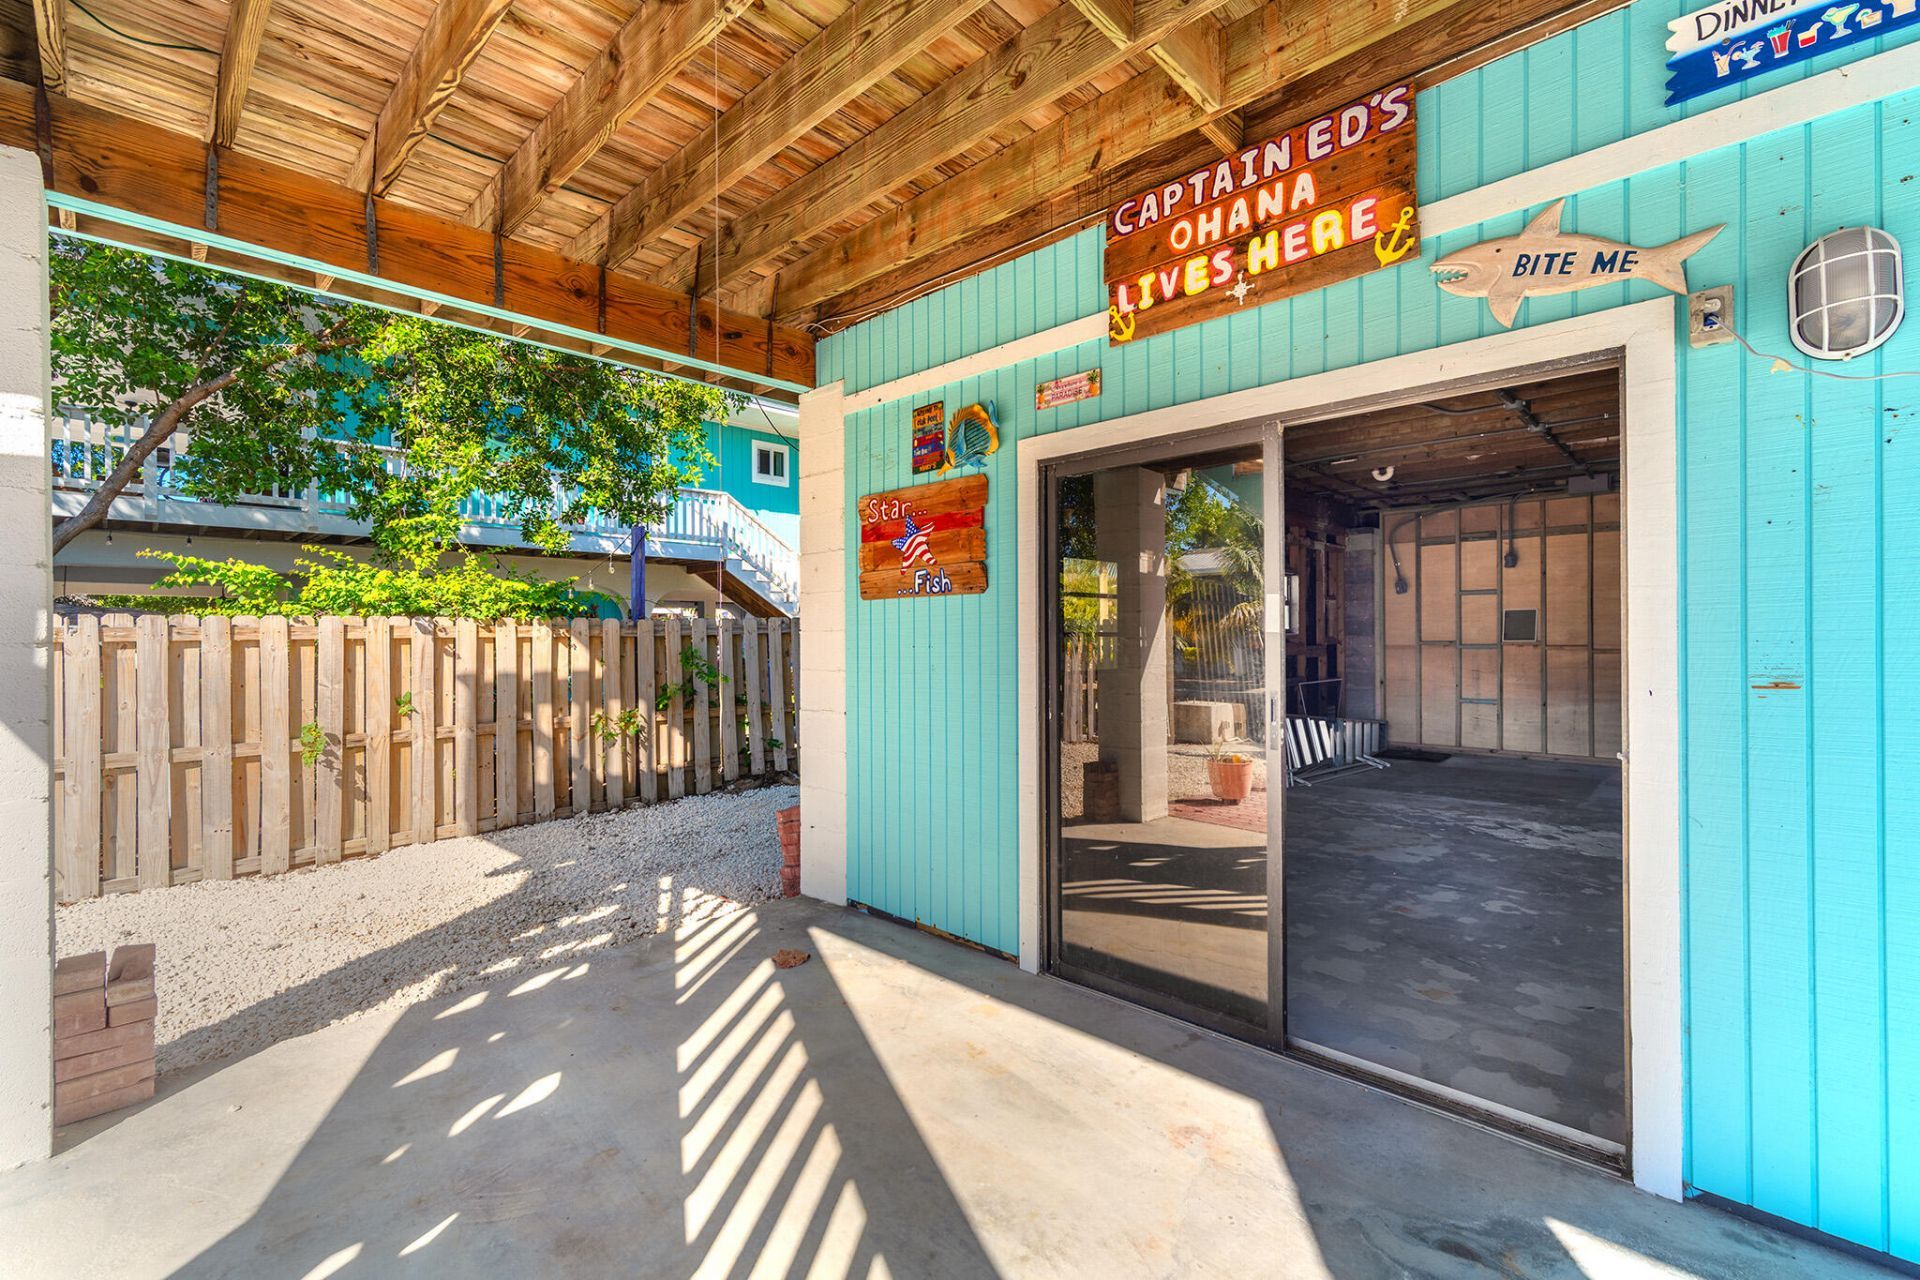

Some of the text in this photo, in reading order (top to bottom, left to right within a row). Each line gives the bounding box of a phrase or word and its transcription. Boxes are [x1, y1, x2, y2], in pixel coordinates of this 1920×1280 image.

[1114, 86, 1409, 236] CAPTAIN ED'S
[1170, 171, 1316, 250] OHANA
[1117, 197, 1378, 313] LIVES HERE
[1512, 250, 1638, 277] BITE ME
[1051, 387, 1083, 400] PARADISE
